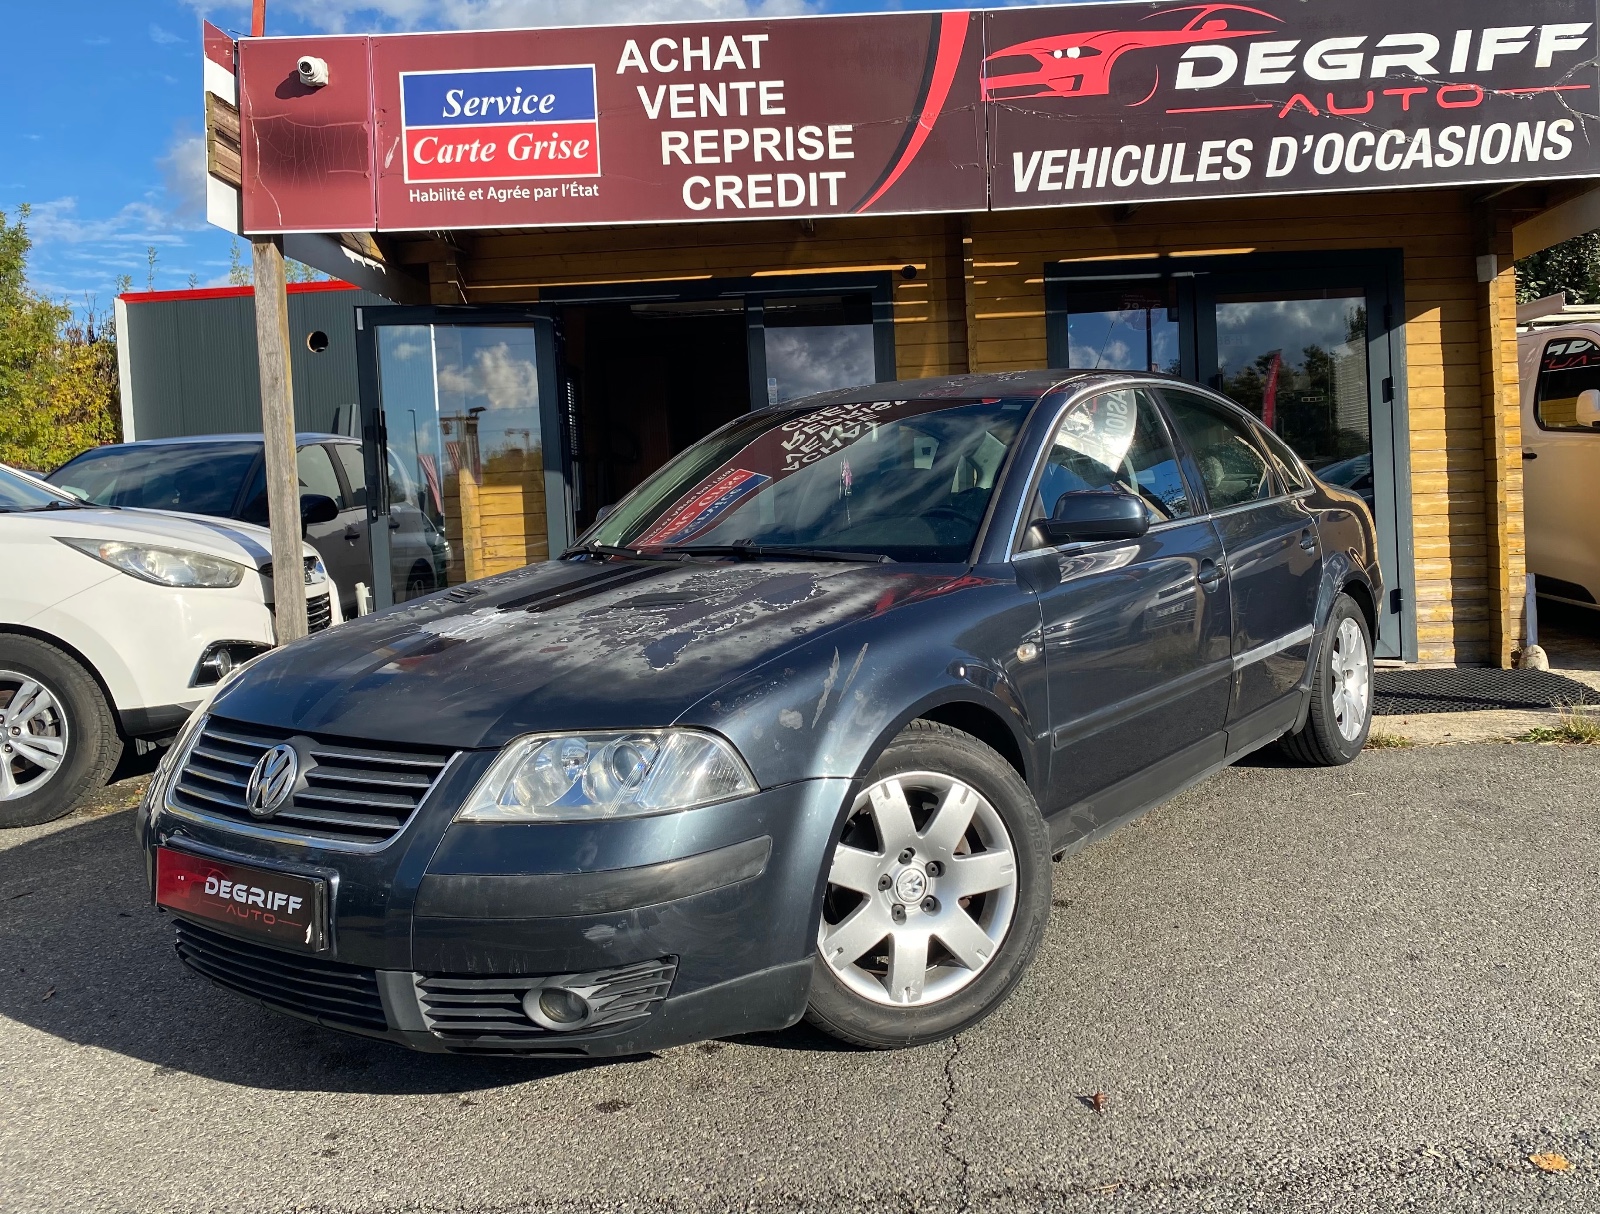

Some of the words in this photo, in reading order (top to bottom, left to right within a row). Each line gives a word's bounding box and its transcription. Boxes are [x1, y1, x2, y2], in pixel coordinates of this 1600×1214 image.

[615, 33, 768, 75] ACHAT
[1176, 23, 1592, 90] DEGRIFF
[443, 87, 555, 118] Service
[636, 80, 785, 119] VENTE
[1278, 83, 1484, 119] AUTO
[413, 136, 496, 164] Carte
[507, 132, 589, 161] Grise
[661, 125, 854, 165] REPRISE
[1012, 139, 1252, 193] VEHICULES
[409, 187, 465, 202] Habilité
[469, 188, 483, 200] et
[487, 185, 530, 202] Agrée
[534, 187, 558, 201] par
[682, 171, 846, 211] CREDIT
[204, 876, 303, 915] DEGRIFF
[225, 904, 277, 925] AUTO
